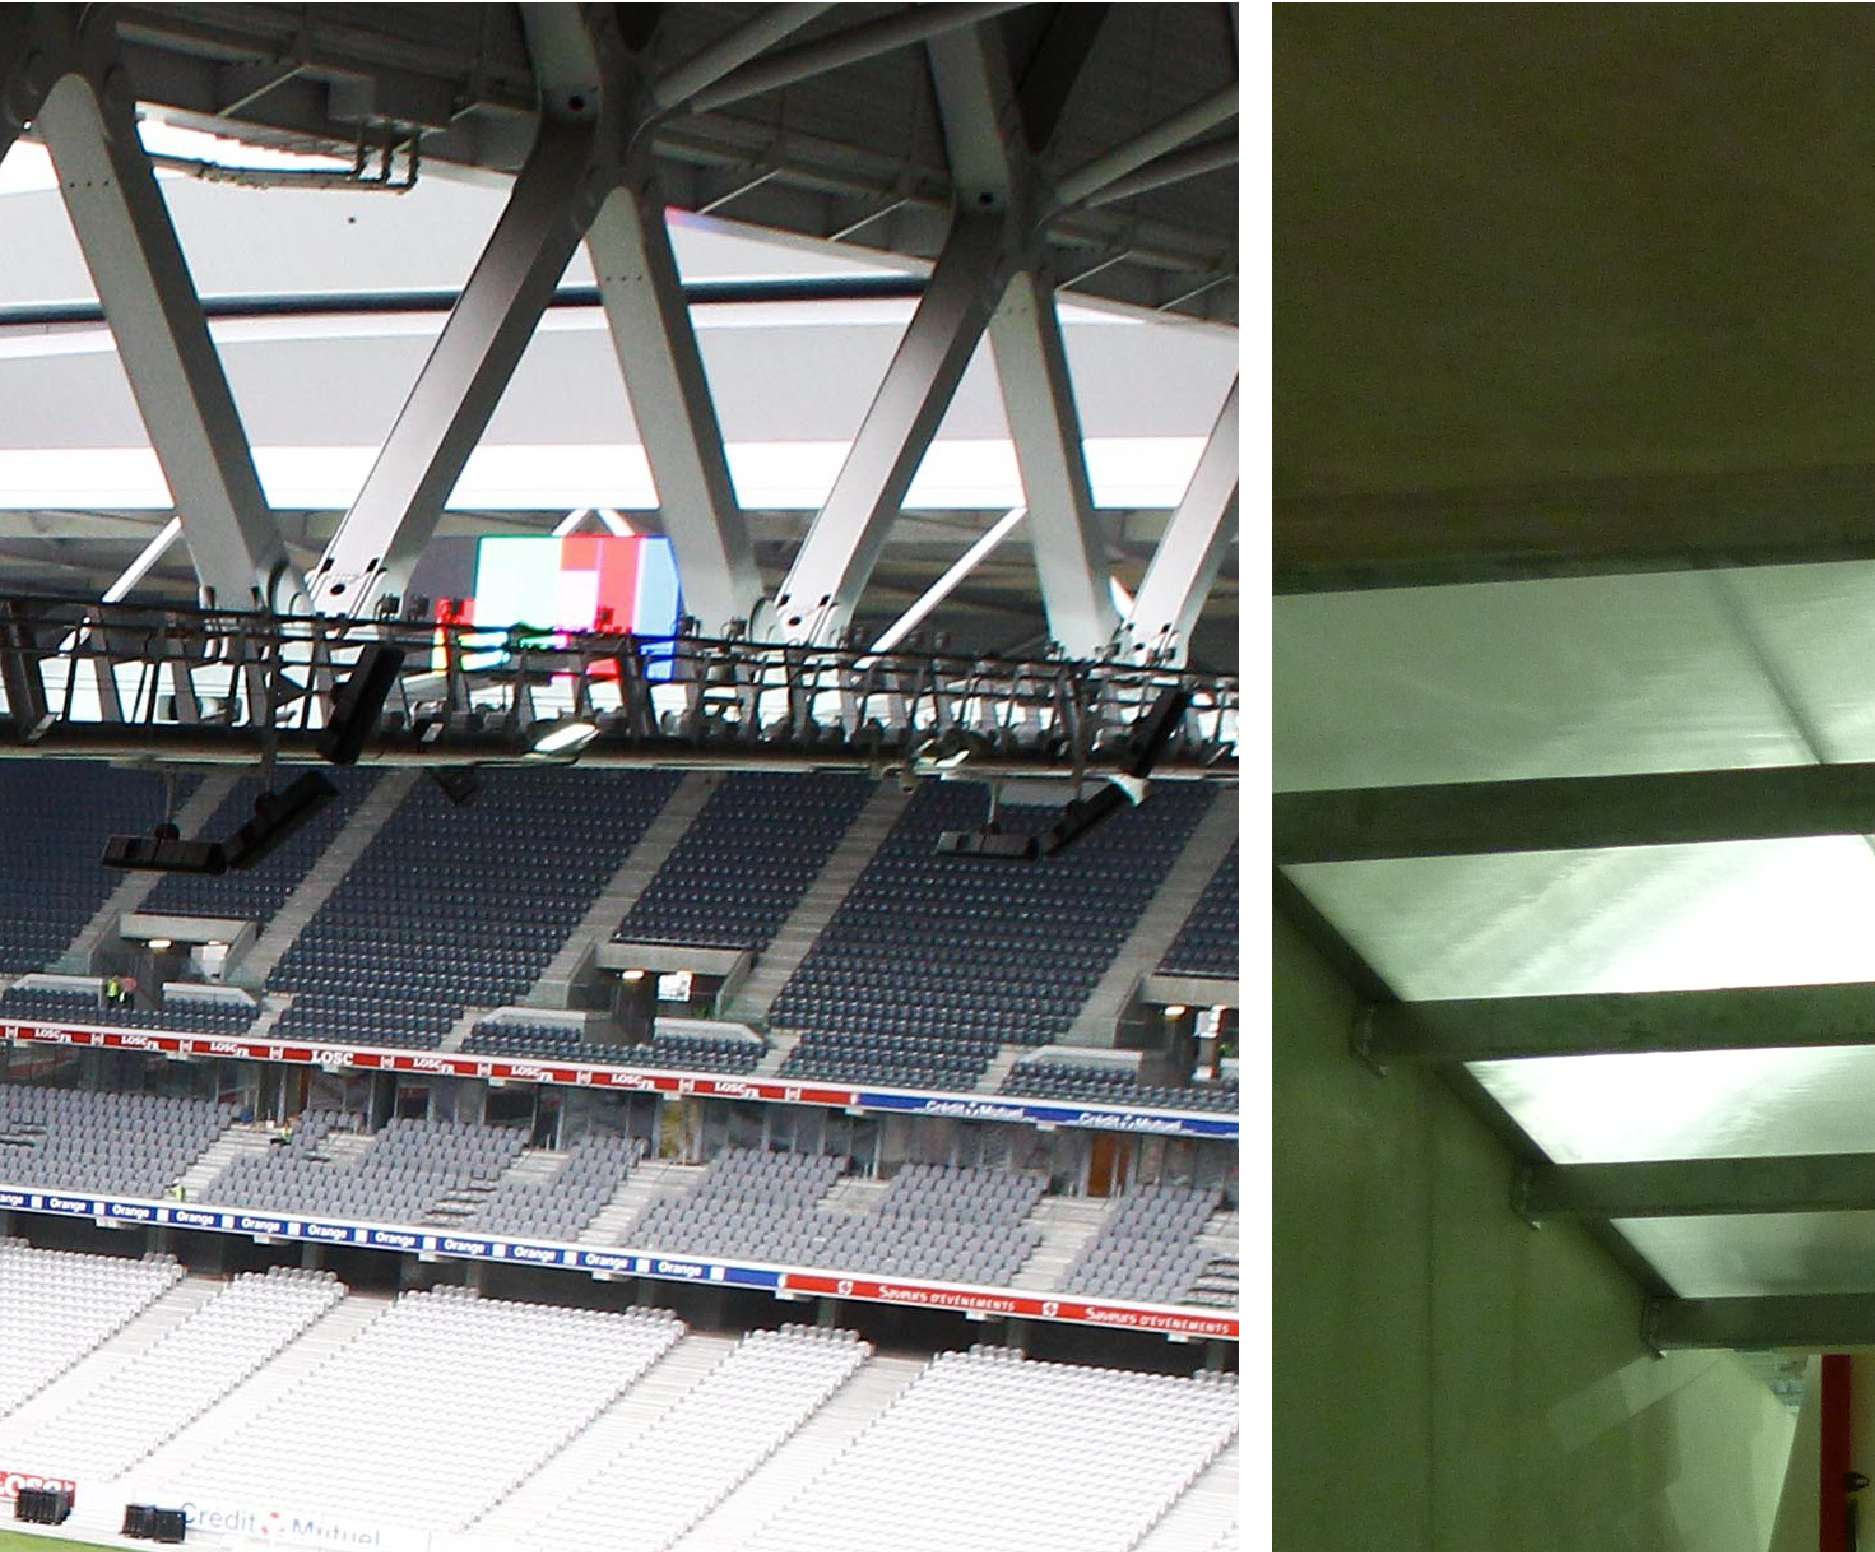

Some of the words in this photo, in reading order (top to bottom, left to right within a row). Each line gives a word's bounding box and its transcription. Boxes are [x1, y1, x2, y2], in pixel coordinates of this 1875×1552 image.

[312, 1050, 353, 1064] LOSC
[50, 1197, 85, 1212] Orange
[112, 1204, 149, 1219] Orange
[176, 1211, 214, 1226] Orange
[242, 1217, 279, 1232] Orange
[308, 1224, 347, 1240] Orange
[375, 1231, 414, 1247] Orange
[444, 1238, 484, 1255] Orange
[514, 1245, 554, 1262] Orange
[585, 1253, 627, 1269] Orange
[658, 1261, 701, 1278] Orange
[182, 1502, 256, 1532] Crédit
